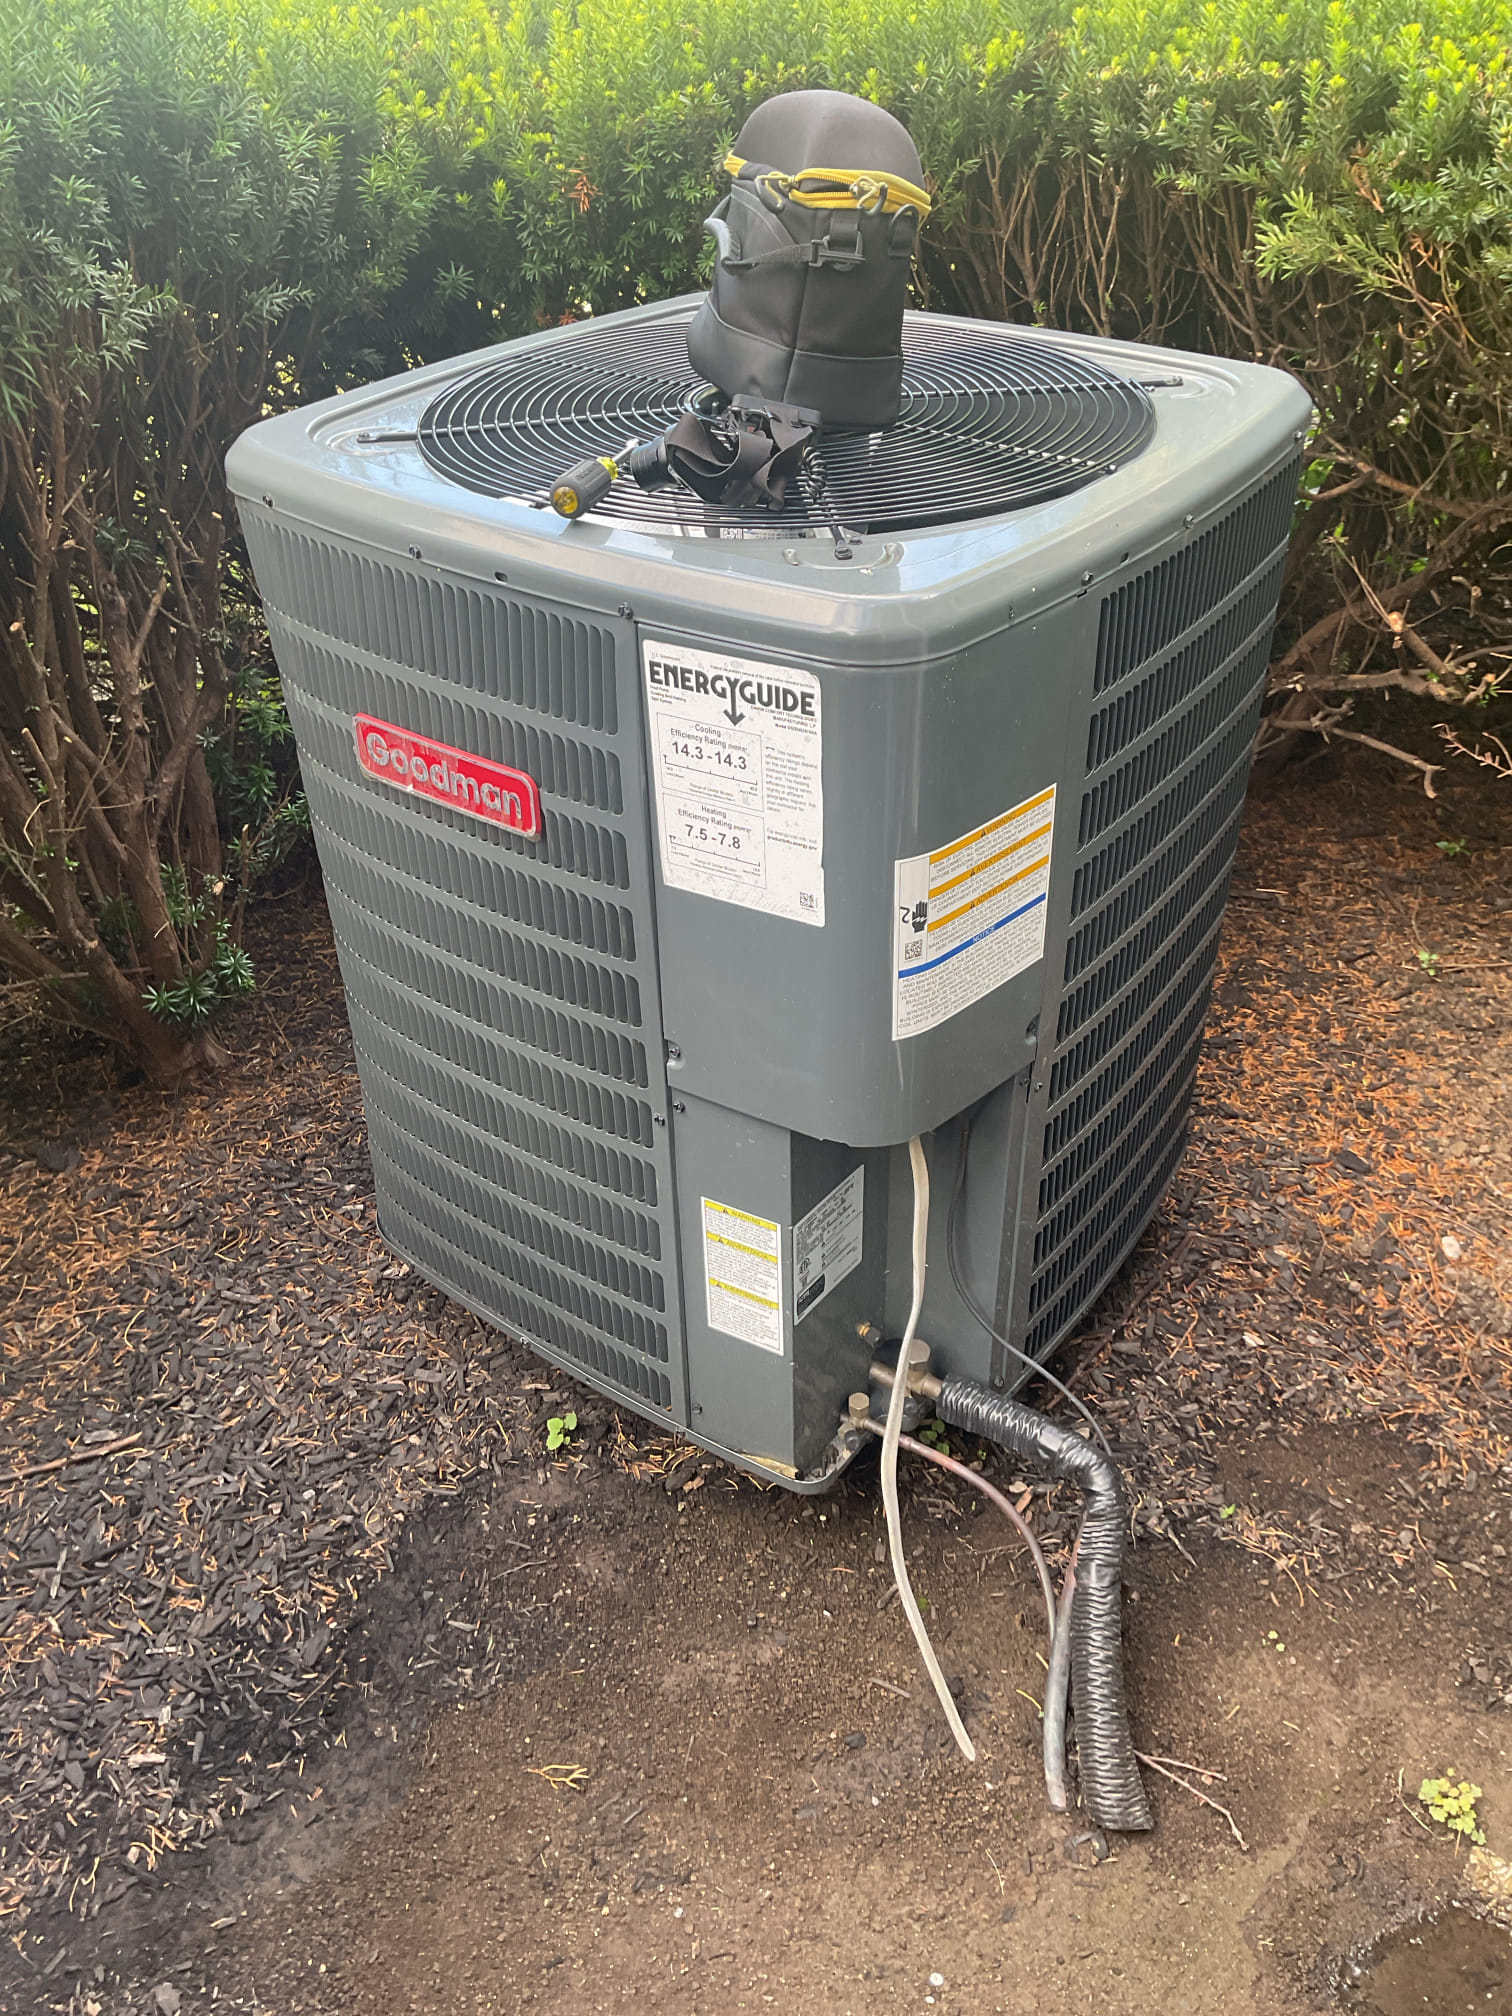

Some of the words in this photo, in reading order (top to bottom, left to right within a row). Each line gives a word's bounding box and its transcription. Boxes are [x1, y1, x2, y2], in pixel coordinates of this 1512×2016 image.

[649, 660, 815, 717] ENERGYGUIDE
[670, 728, 703, 745] Efficiency
[704, 735, 726, 749] Rating
[695, 723, 721, 737] Cooling
[366, 733, 522, 820] Goodman
[678, 808, 710, 825] Efficiency
[711, 816, 732, 830] Rating
[701, 804, 727, 819] Heating
[972, 924, 994, 944] NOTICE
